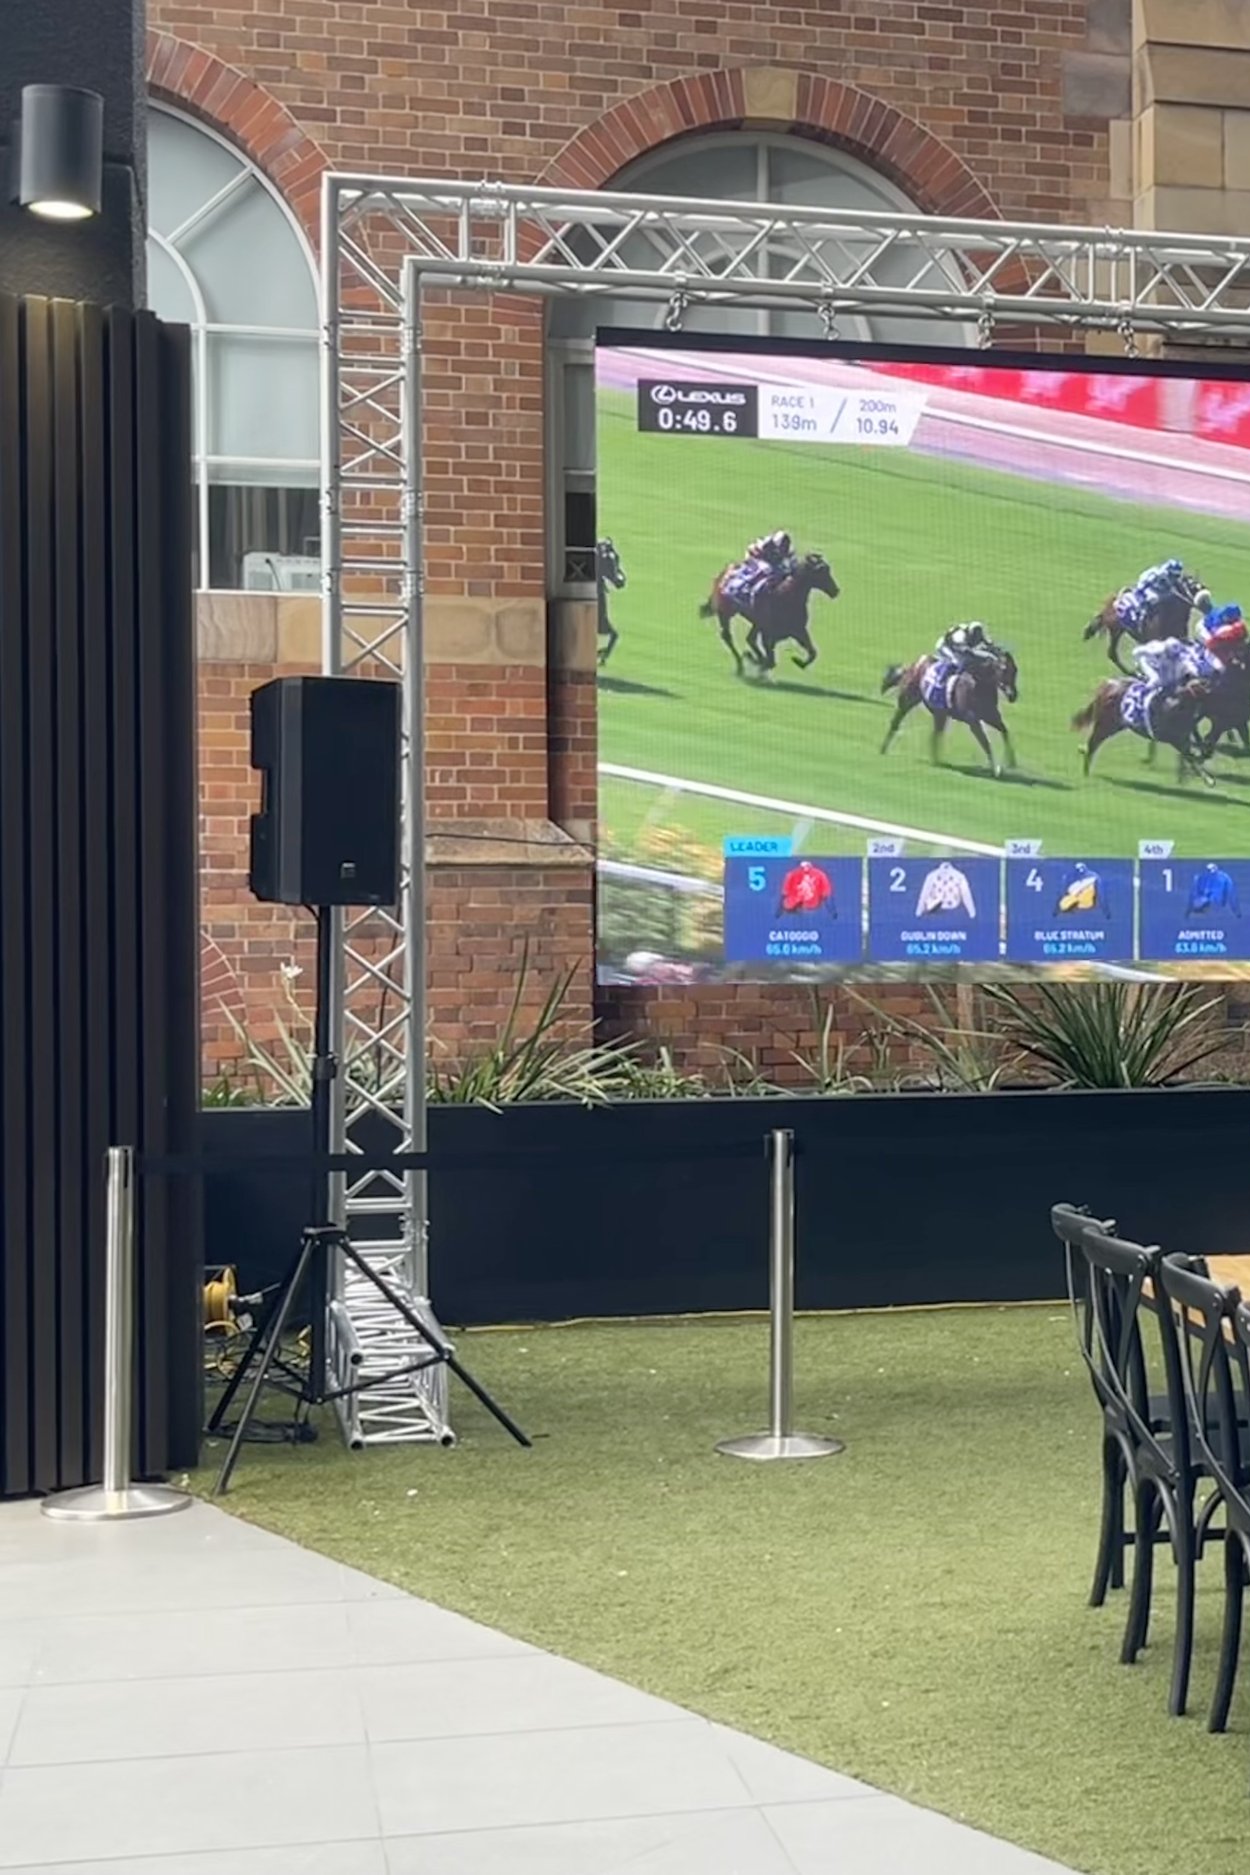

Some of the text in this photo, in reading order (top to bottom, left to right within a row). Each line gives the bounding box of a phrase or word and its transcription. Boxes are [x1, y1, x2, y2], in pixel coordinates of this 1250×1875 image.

[677, 390, 746, 405] LEXUS
[771, 395, 815, 408] RACE 1
[859, 398, 897, 412] 200m
[658, 407, 737, 432] 0:49.6
[772, 413, 817, 431] 139m
[857, 417, 899, 435] 10.94
[730, 841, 778, 852] LEADER
[872, 842, 895, 853] 2nd
[1011, 843, 1031, 854] 3rd
[1143, 844, 1164, 855] 4th
[748, 867, 766, 891] 5
[889, 868, 907, 892] 2
[1026, 868, 1044, 892] 4
[1162, 869, 1174, 892] 1
